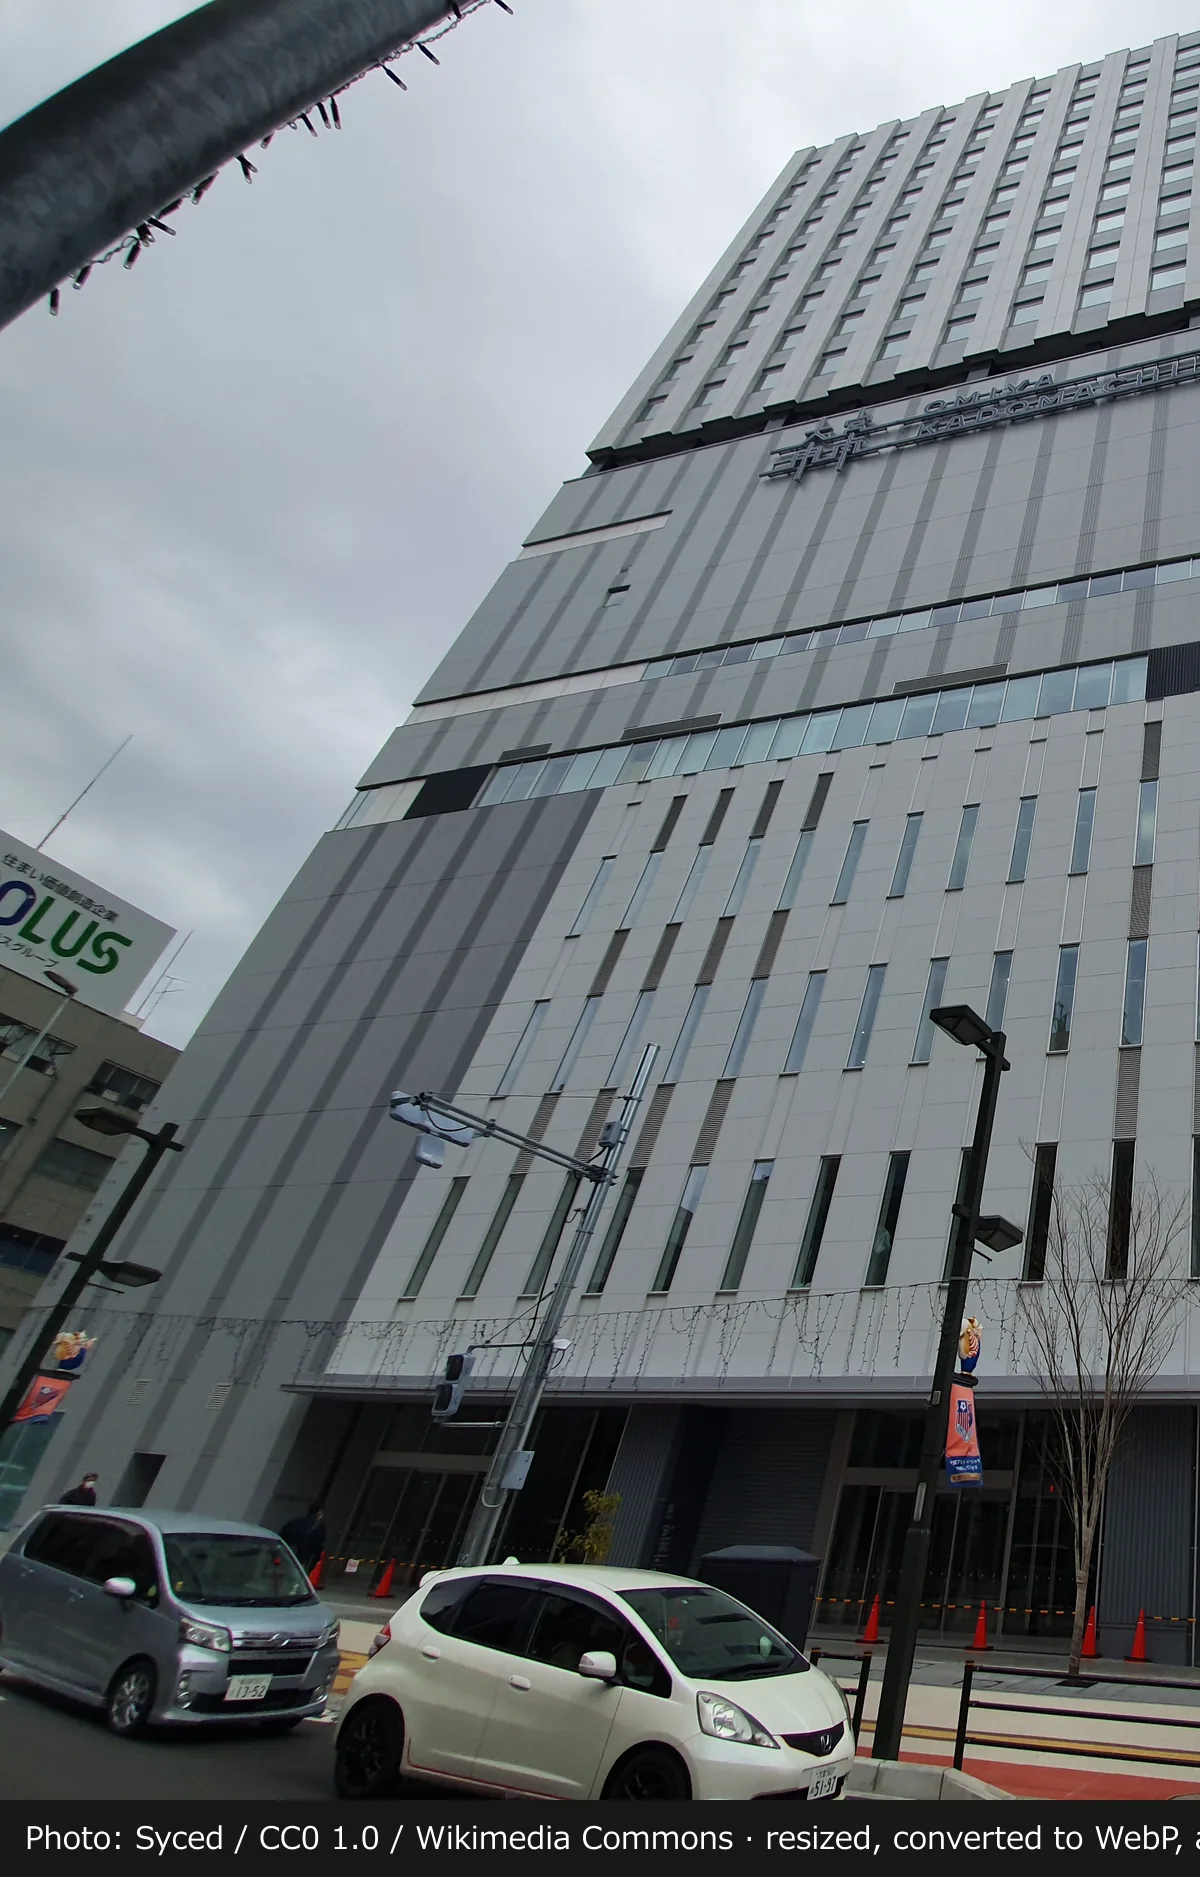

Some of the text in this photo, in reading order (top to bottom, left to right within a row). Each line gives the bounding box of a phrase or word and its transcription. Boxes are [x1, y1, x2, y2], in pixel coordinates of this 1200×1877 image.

[915, 361, 1180, 438] KADOMACHI
[923, 372, 1056, 414] OMIYA
[1, 852, 120, 924] 住まい価値創造企業
[0, 933, 59, 968] スグループ
[235, 1685, 266, 1698] 13-52
